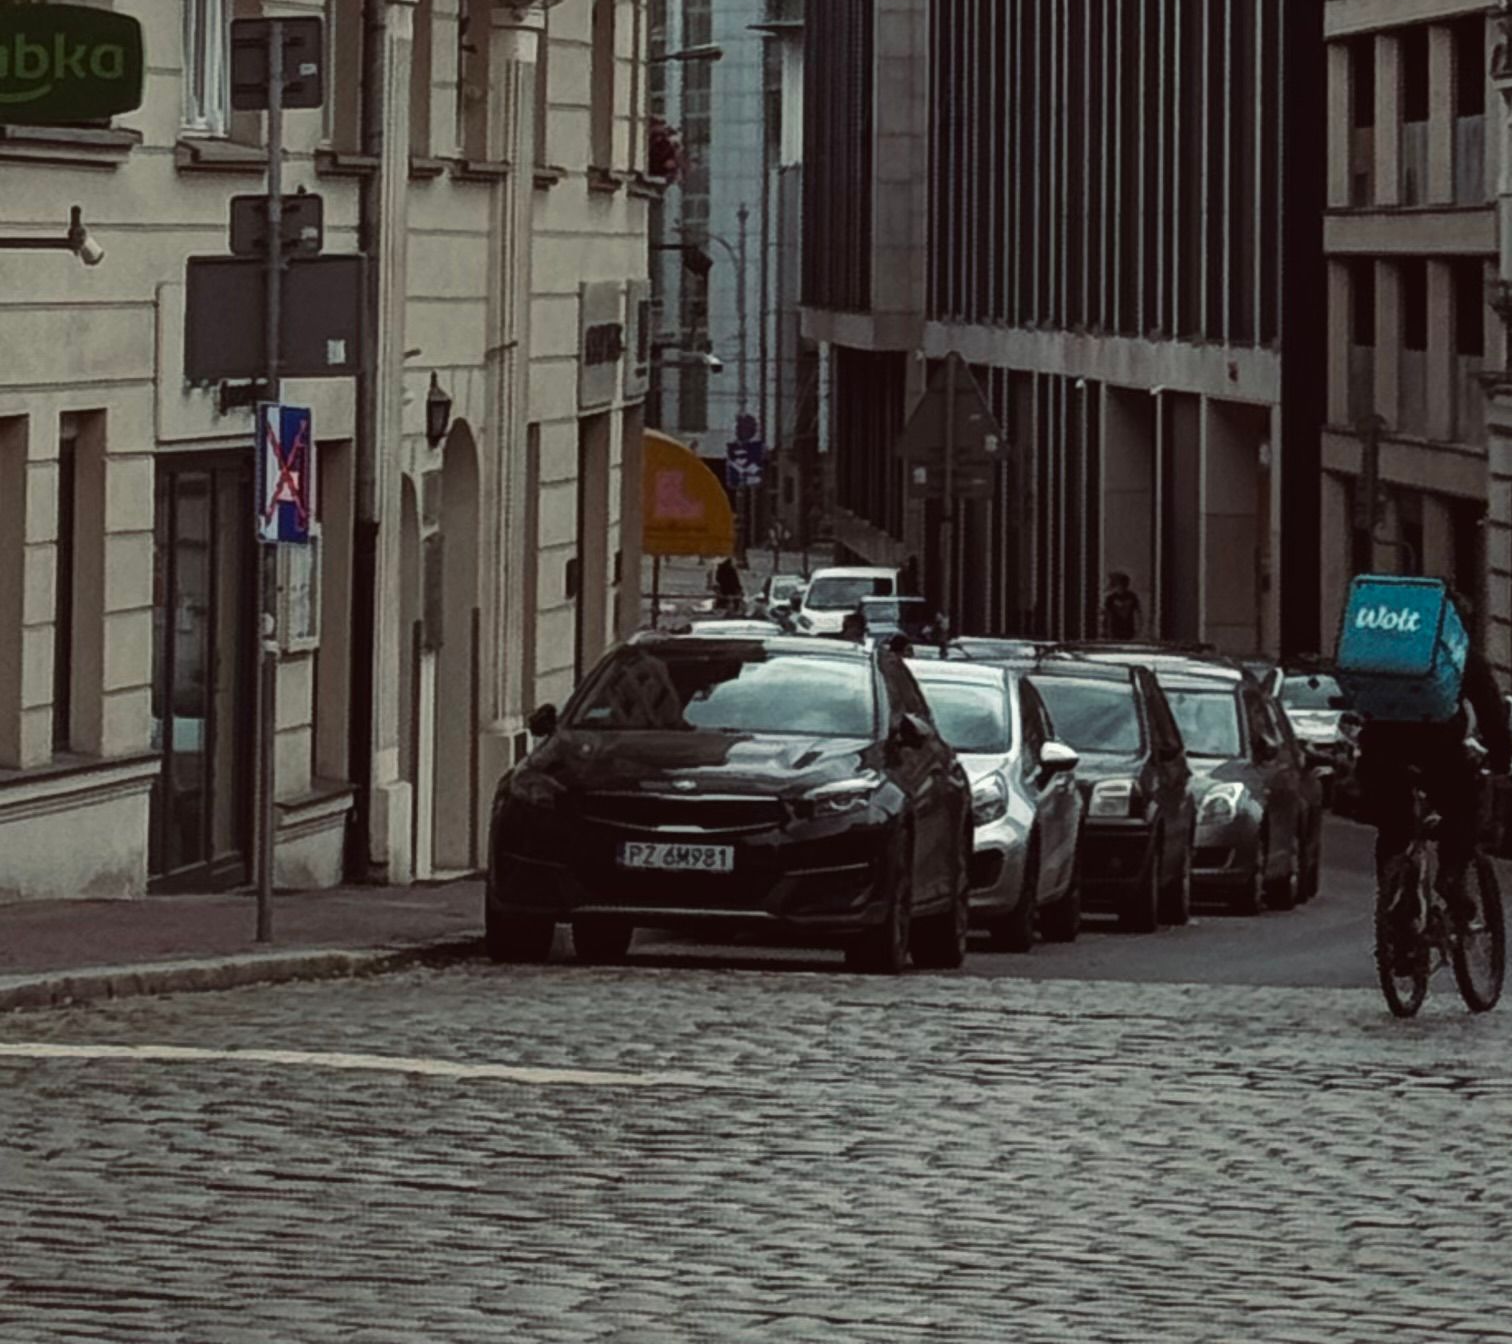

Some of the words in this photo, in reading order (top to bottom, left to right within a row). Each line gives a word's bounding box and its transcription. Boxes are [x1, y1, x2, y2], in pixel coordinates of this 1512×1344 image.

[0, 31, 124, 80] bka
[1355, 605, 1421, 632] Wolt
[629, 844, 657, 865] PZ
